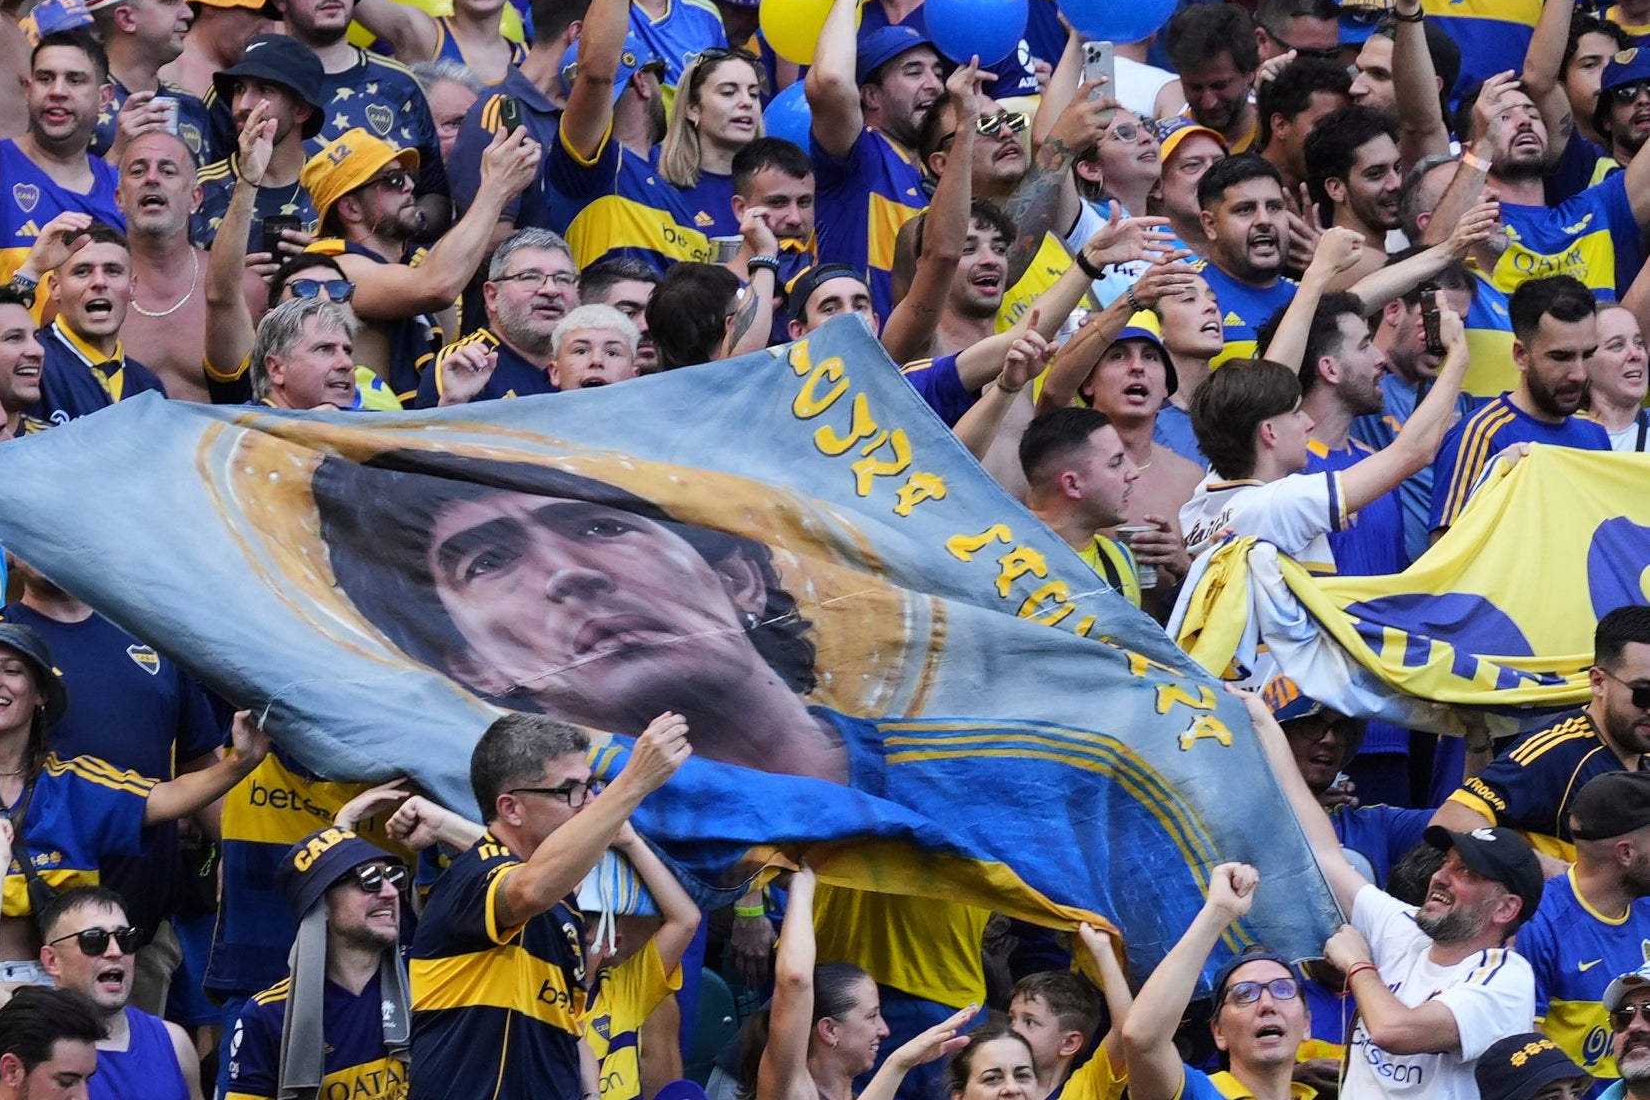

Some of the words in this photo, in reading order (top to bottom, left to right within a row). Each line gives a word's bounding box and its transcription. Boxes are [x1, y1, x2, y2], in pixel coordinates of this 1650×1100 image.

[327, 143, 352, 168] 12
[293, 827, 357, 872] CABJ
[327, 1066, 403, 1100] QATA
